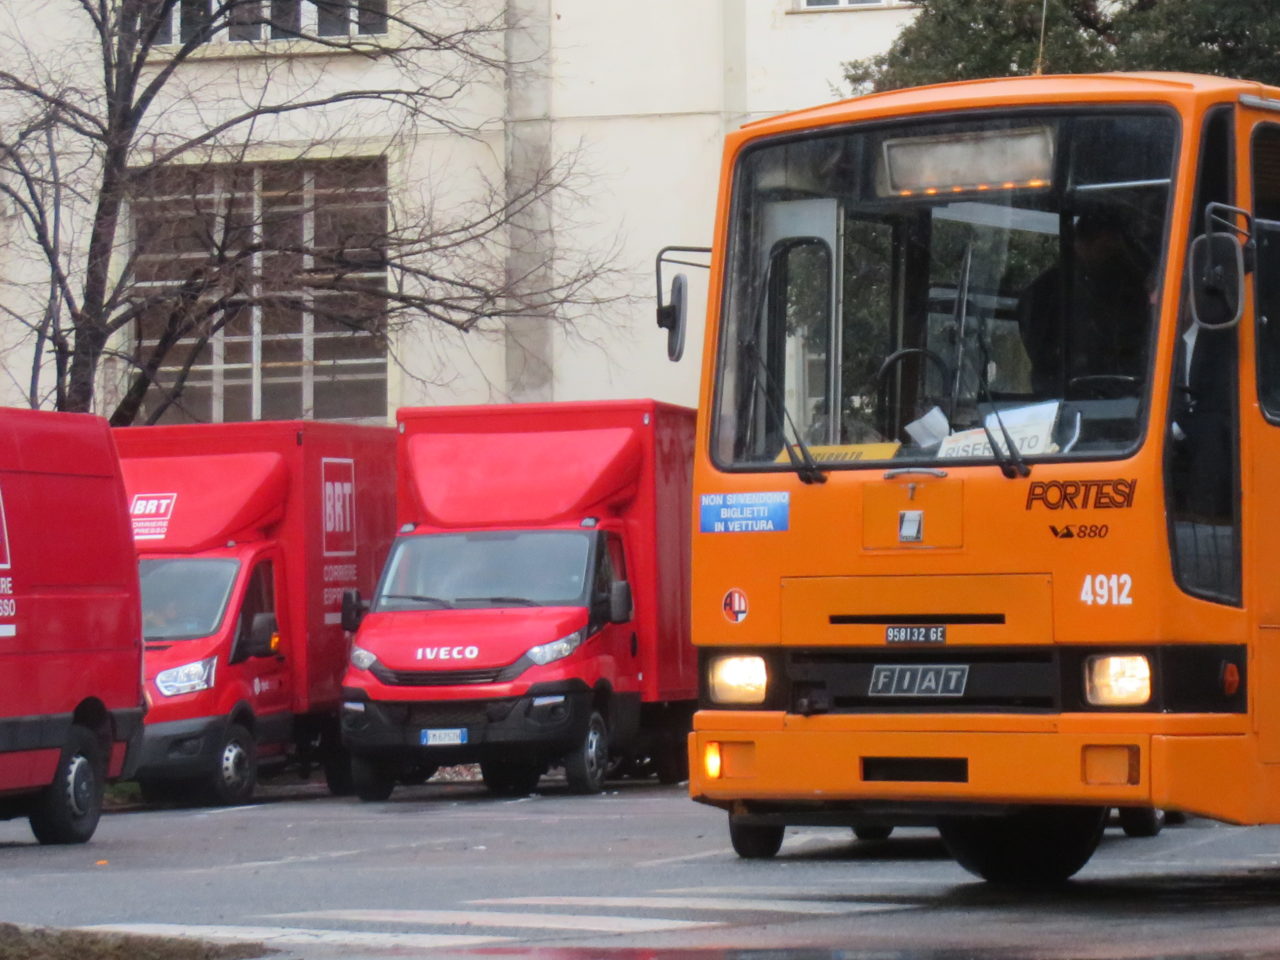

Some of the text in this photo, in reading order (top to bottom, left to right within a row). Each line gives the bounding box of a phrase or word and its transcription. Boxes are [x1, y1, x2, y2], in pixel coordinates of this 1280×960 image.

[945, 434, 1040, 457] RISERTO
[701, 490, 788, 507] NON SI VENDONO
[1025, 478, 1138, 511] PORTESI
[134, 499, 171, 514] BRT
[325, 481, 352, 532] BRT
[720, 505, 769, 519] BIGLIETTI
[714, 519, 775, 533] IN VETTURA
[1077, 524, 1110, 539] 880
[1080, 573, 1134, 606] 4912
[887, 627, 945, 641] 958132 GE
[416, 645, 480, 660] IVECO
[876, 670, 963, 691] FIAT
